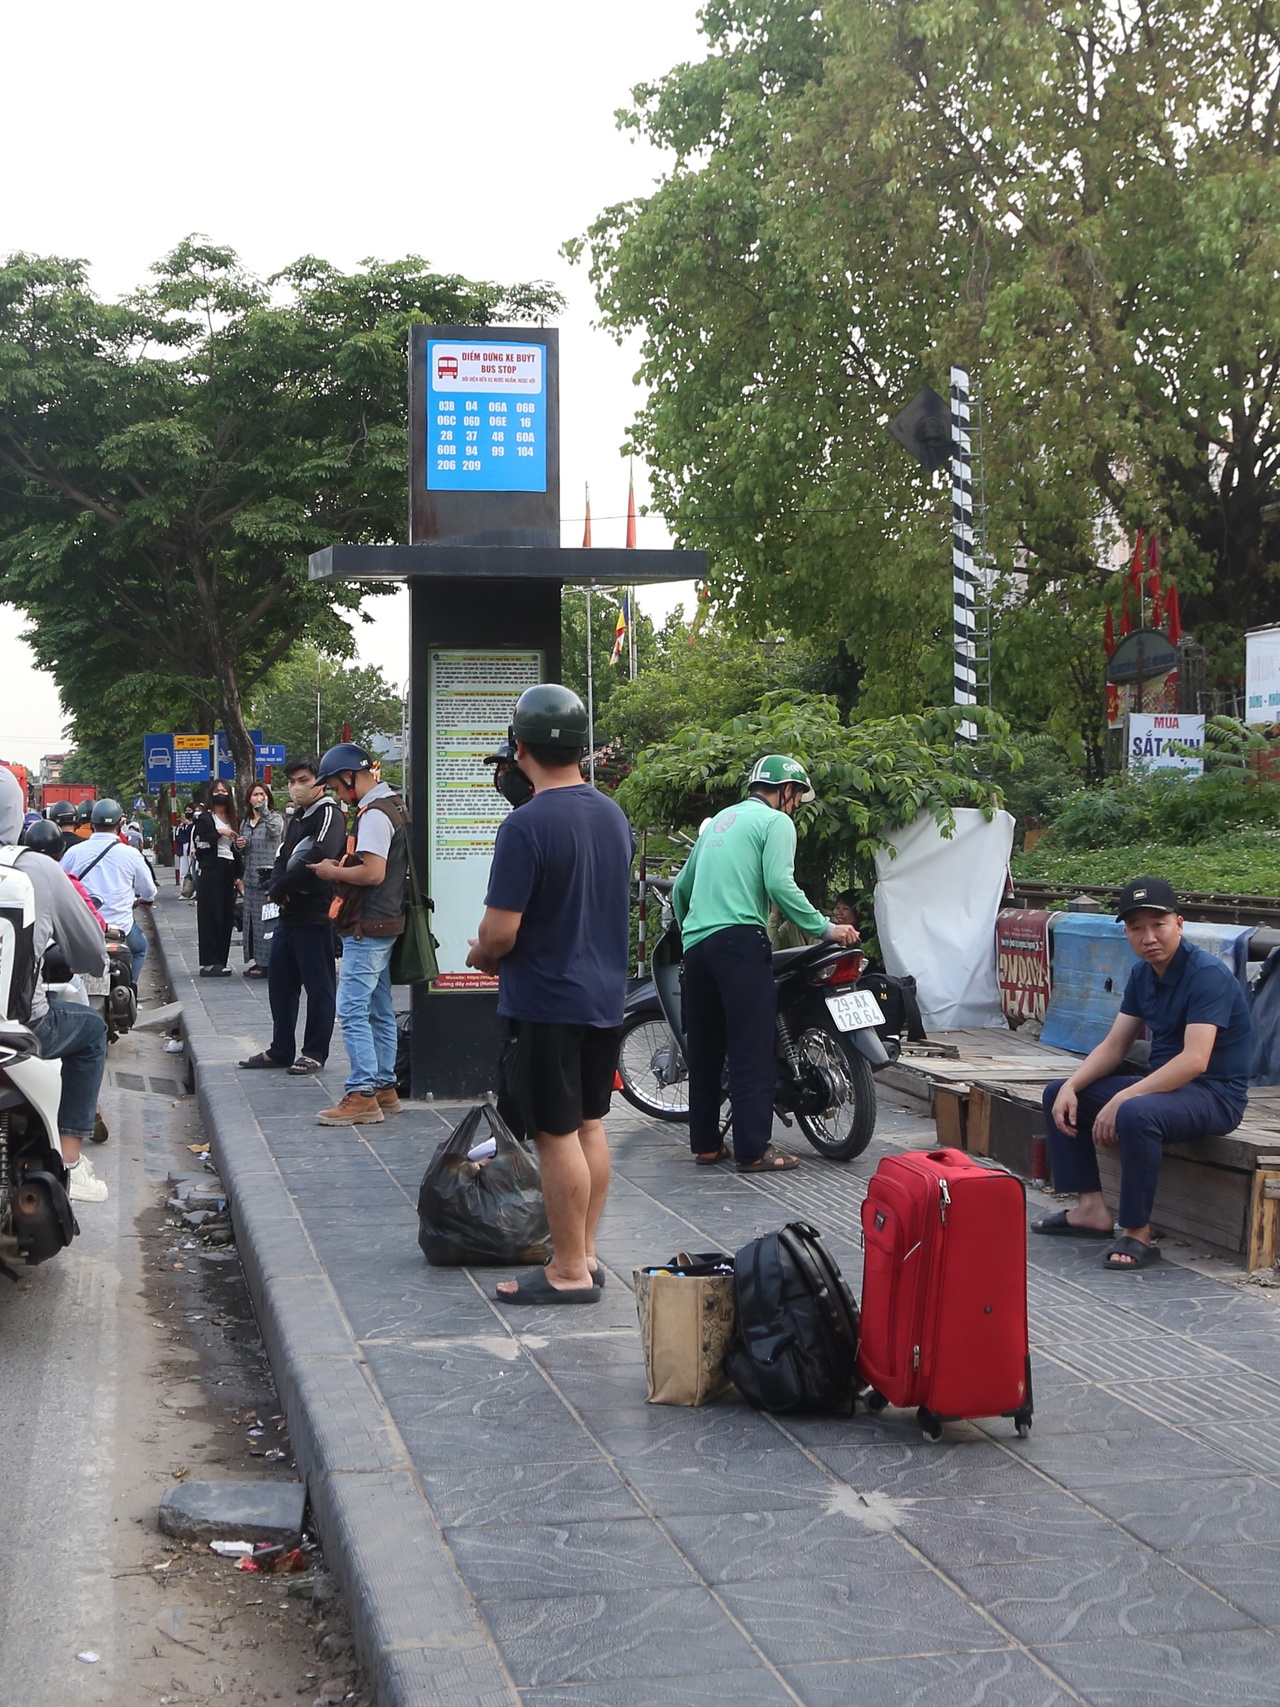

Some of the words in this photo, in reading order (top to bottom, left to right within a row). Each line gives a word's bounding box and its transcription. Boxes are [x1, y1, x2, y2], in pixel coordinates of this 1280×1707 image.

[462, 350, 480, 361] ĐIỂM
[483, 352, 503, 362] DỪNG
[505, 354, 514, 362] XE
[517, 352, 535, 363] BUÝT
[481, 365, 496, 373] BUS
[498, 366, 517, 374] STOP
[438, 400, 455, 411] 03B
[465, 401, 478, 411] 04
[488, 402, 507, 412] 06A
[516, 402, 535, 413] 06B
[437, 415, 456, 426] 06C
[463, 416, 480, 426] 06D
[489, 416, 507, 427] 06E
[520, 417, 531, 427] 16
[440, 430, 453, 441] 28
[466, 430, 478, 441] 37
[491, 431, 504, 442] 48
[516, 432, 535, 442] 60A
[437, 445, 456, 455] 60B
[465, 445, 478, 456] 94
[491, 446, 504, 456] 99
[517, 446, 534, 456] 104
[437, 460, 456, 471] 206
[462, 460, 481, 471] 209
[1154, 717, 1179, 729] MUA
[1133, 730, 1163, 757] SẮT
[833, 994, 870, 1013] 29-AX
[838, 1008, 881, 1028] 128.64
